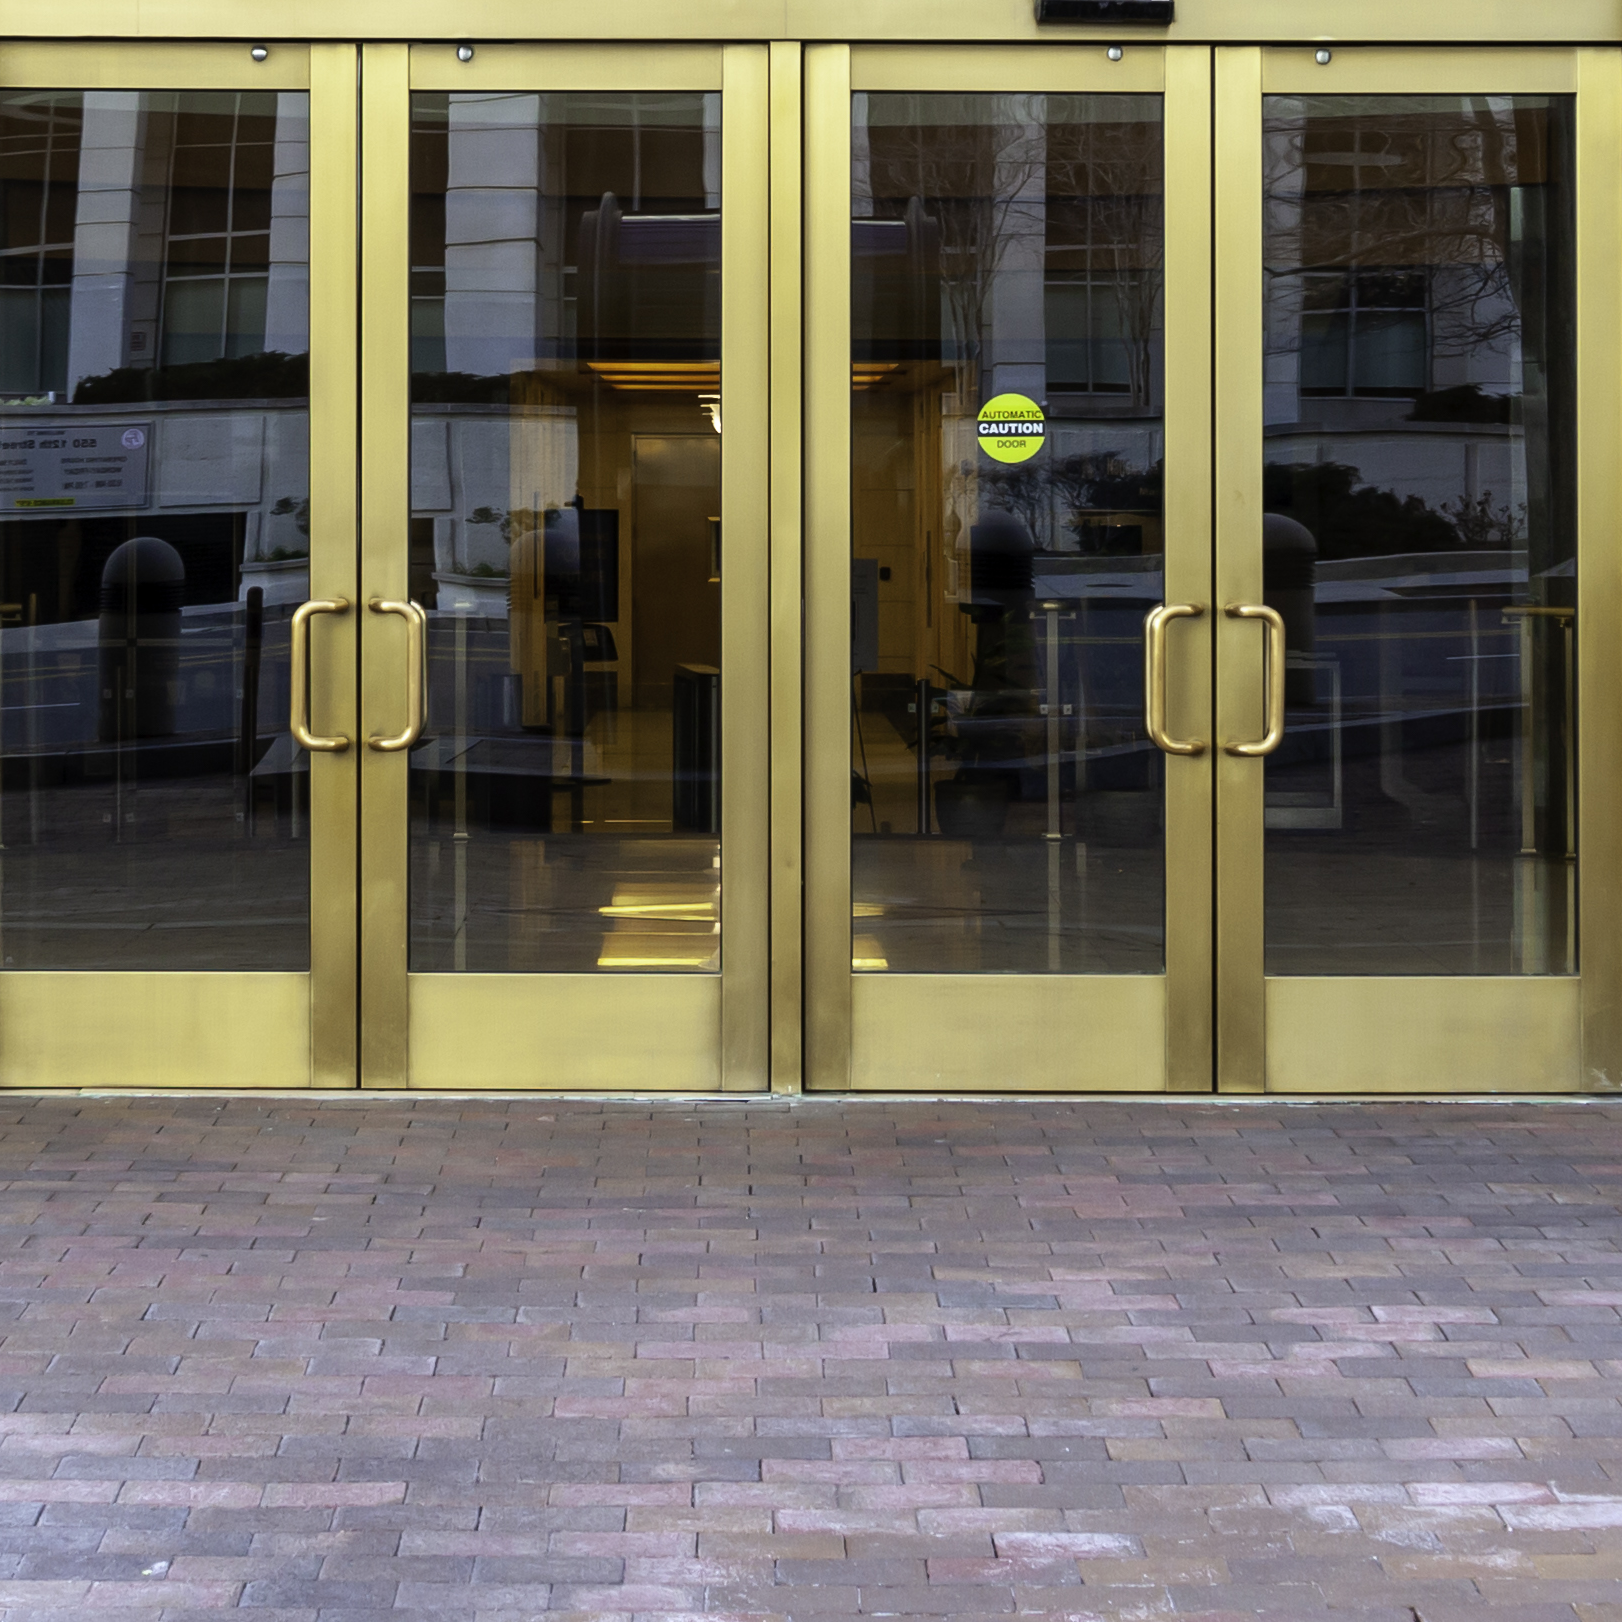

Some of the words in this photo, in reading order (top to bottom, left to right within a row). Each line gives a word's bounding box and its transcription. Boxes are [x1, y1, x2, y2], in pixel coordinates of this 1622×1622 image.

[982, 410, 1041, 419] AUTOMATIC
[979, 423, 1043, 434] CAUTION
[997, 440, 1026, 448] DOOR
